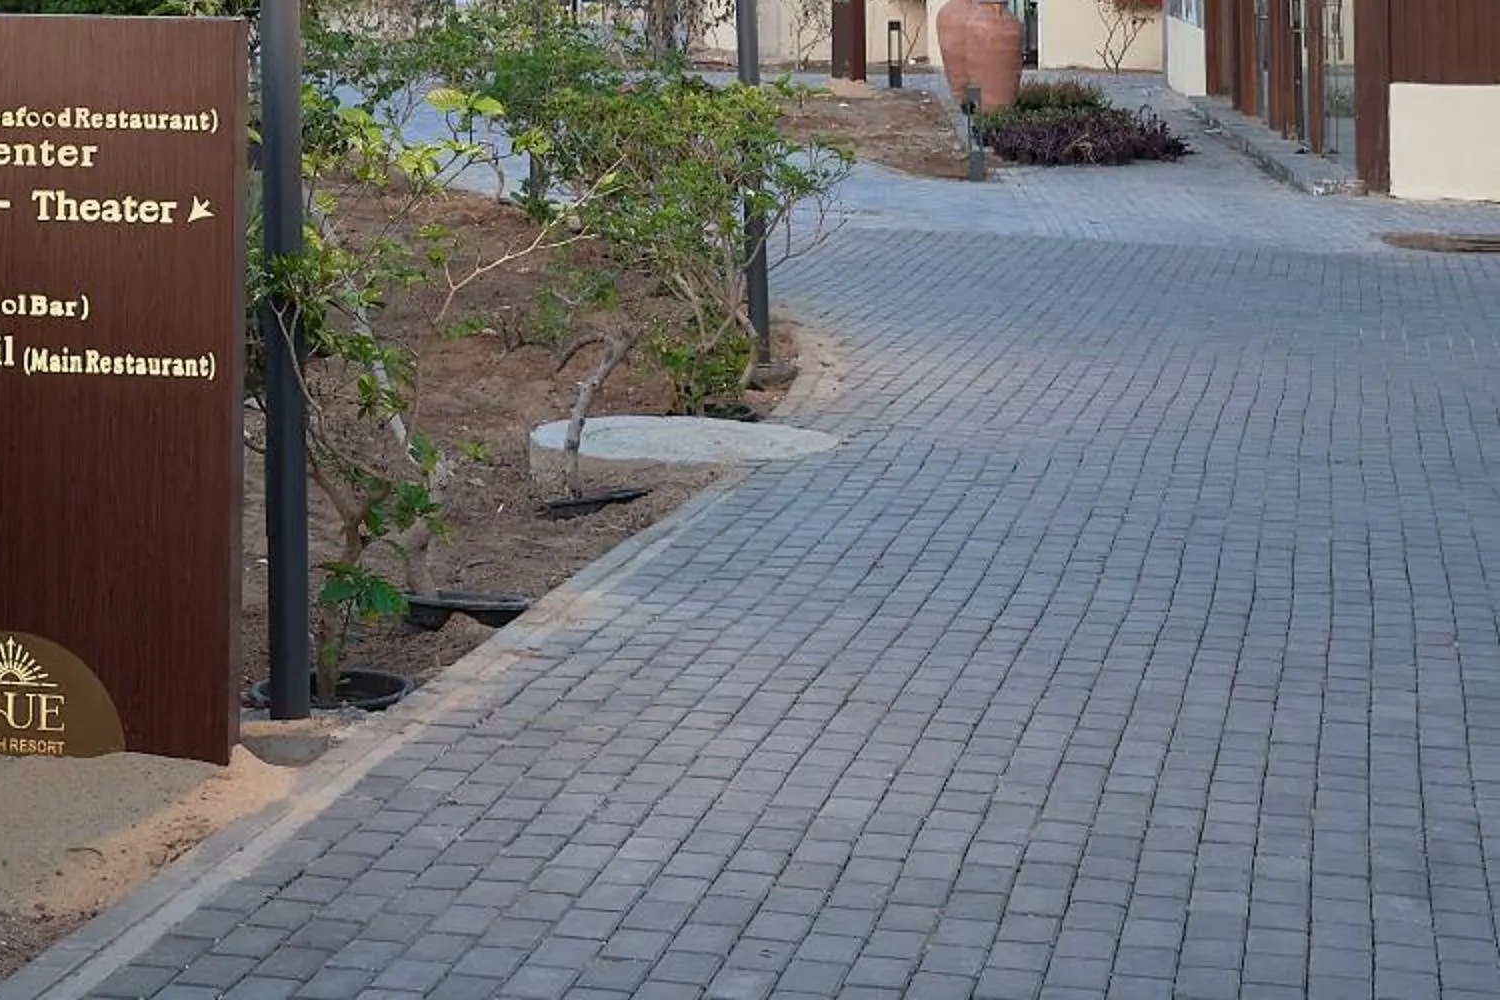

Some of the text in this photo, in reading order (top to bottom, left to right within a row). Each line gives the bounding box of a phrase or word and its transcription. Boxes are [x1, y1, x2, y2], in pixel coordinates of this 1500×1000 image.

[74, 107, 218, 134] Restaurant)
[31, 190, 177, 224] Theater
[9, 738, 66, 755] RESORT
